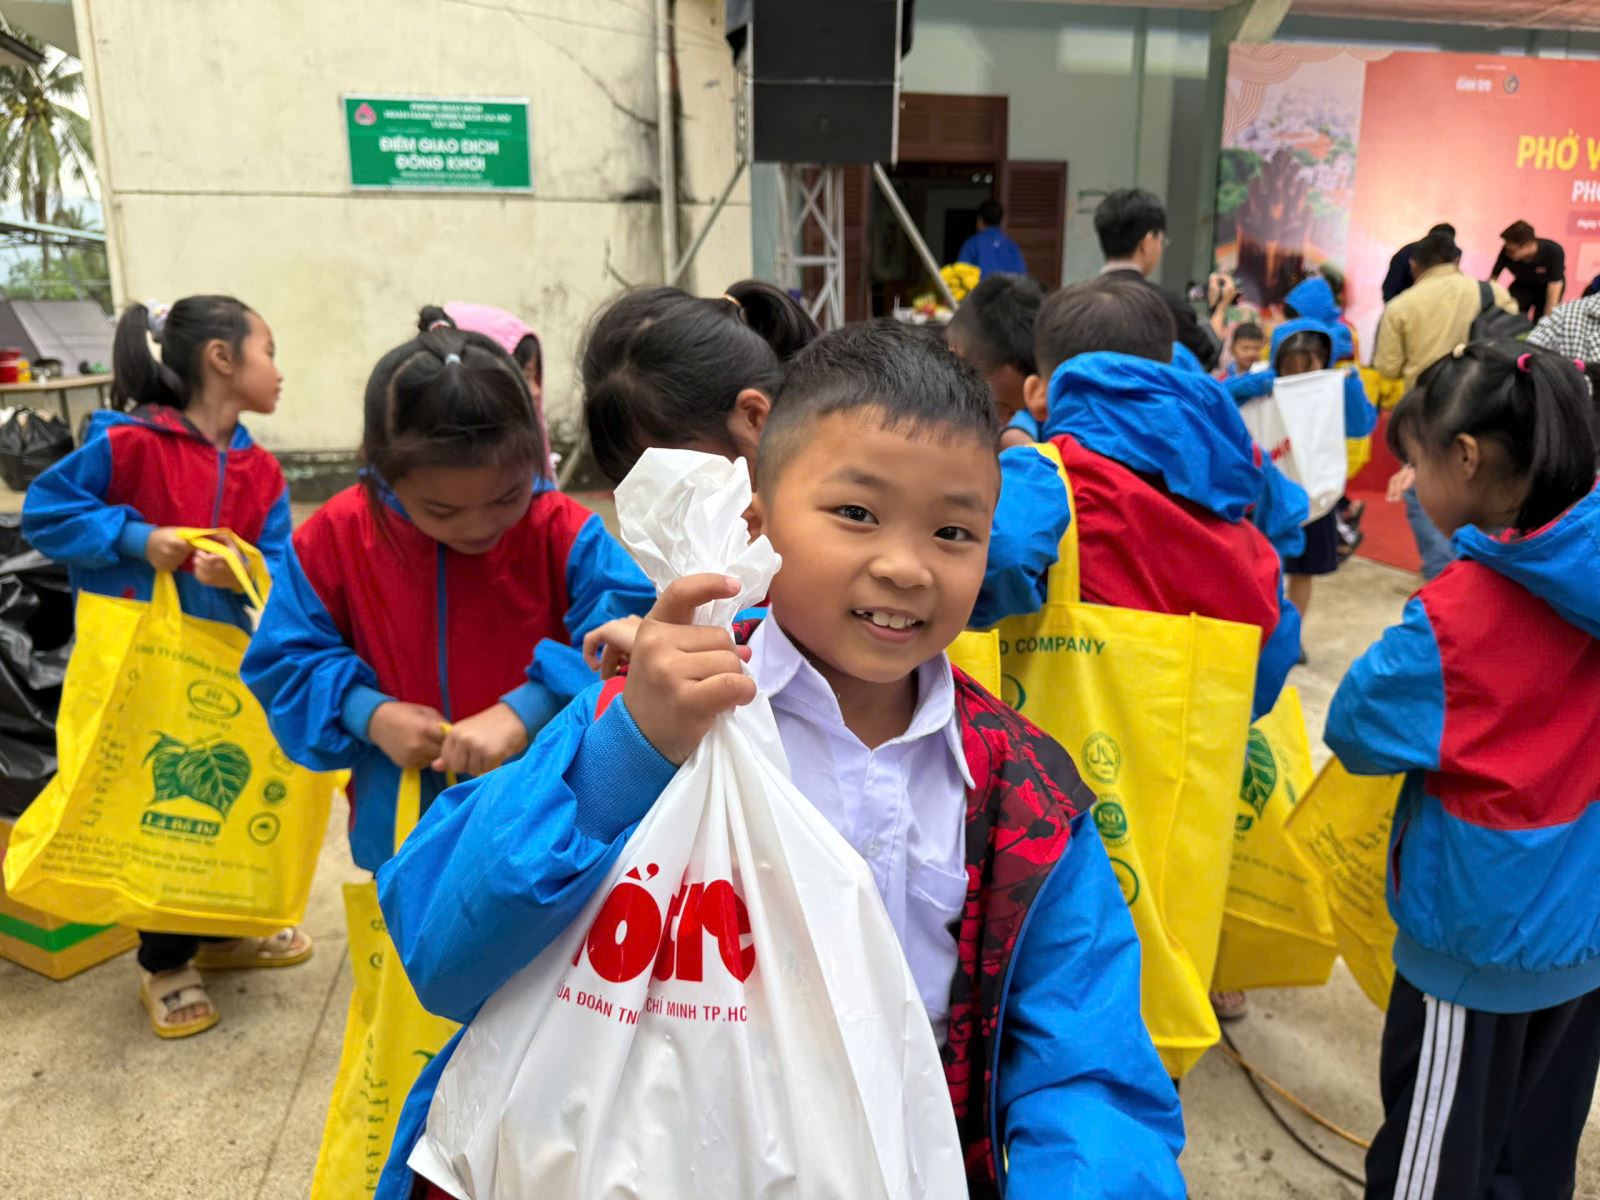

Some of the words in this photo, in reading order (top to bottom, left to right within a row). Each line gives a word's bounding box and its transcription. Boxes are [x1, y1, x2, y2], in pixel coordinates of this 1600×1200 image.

[418, 137, 459, 154] GIAO
[1516, 128, 1579, 171] PHỞ
[1015, 636, 1106, 655] COMPANY
[1098, 809, 1123, 824] ISO
[576, 990, 613, 1018] ĐOÀN
[646, 996, 664, 1015] CHÍ
[667, 1001, 697, 1020] MINH
